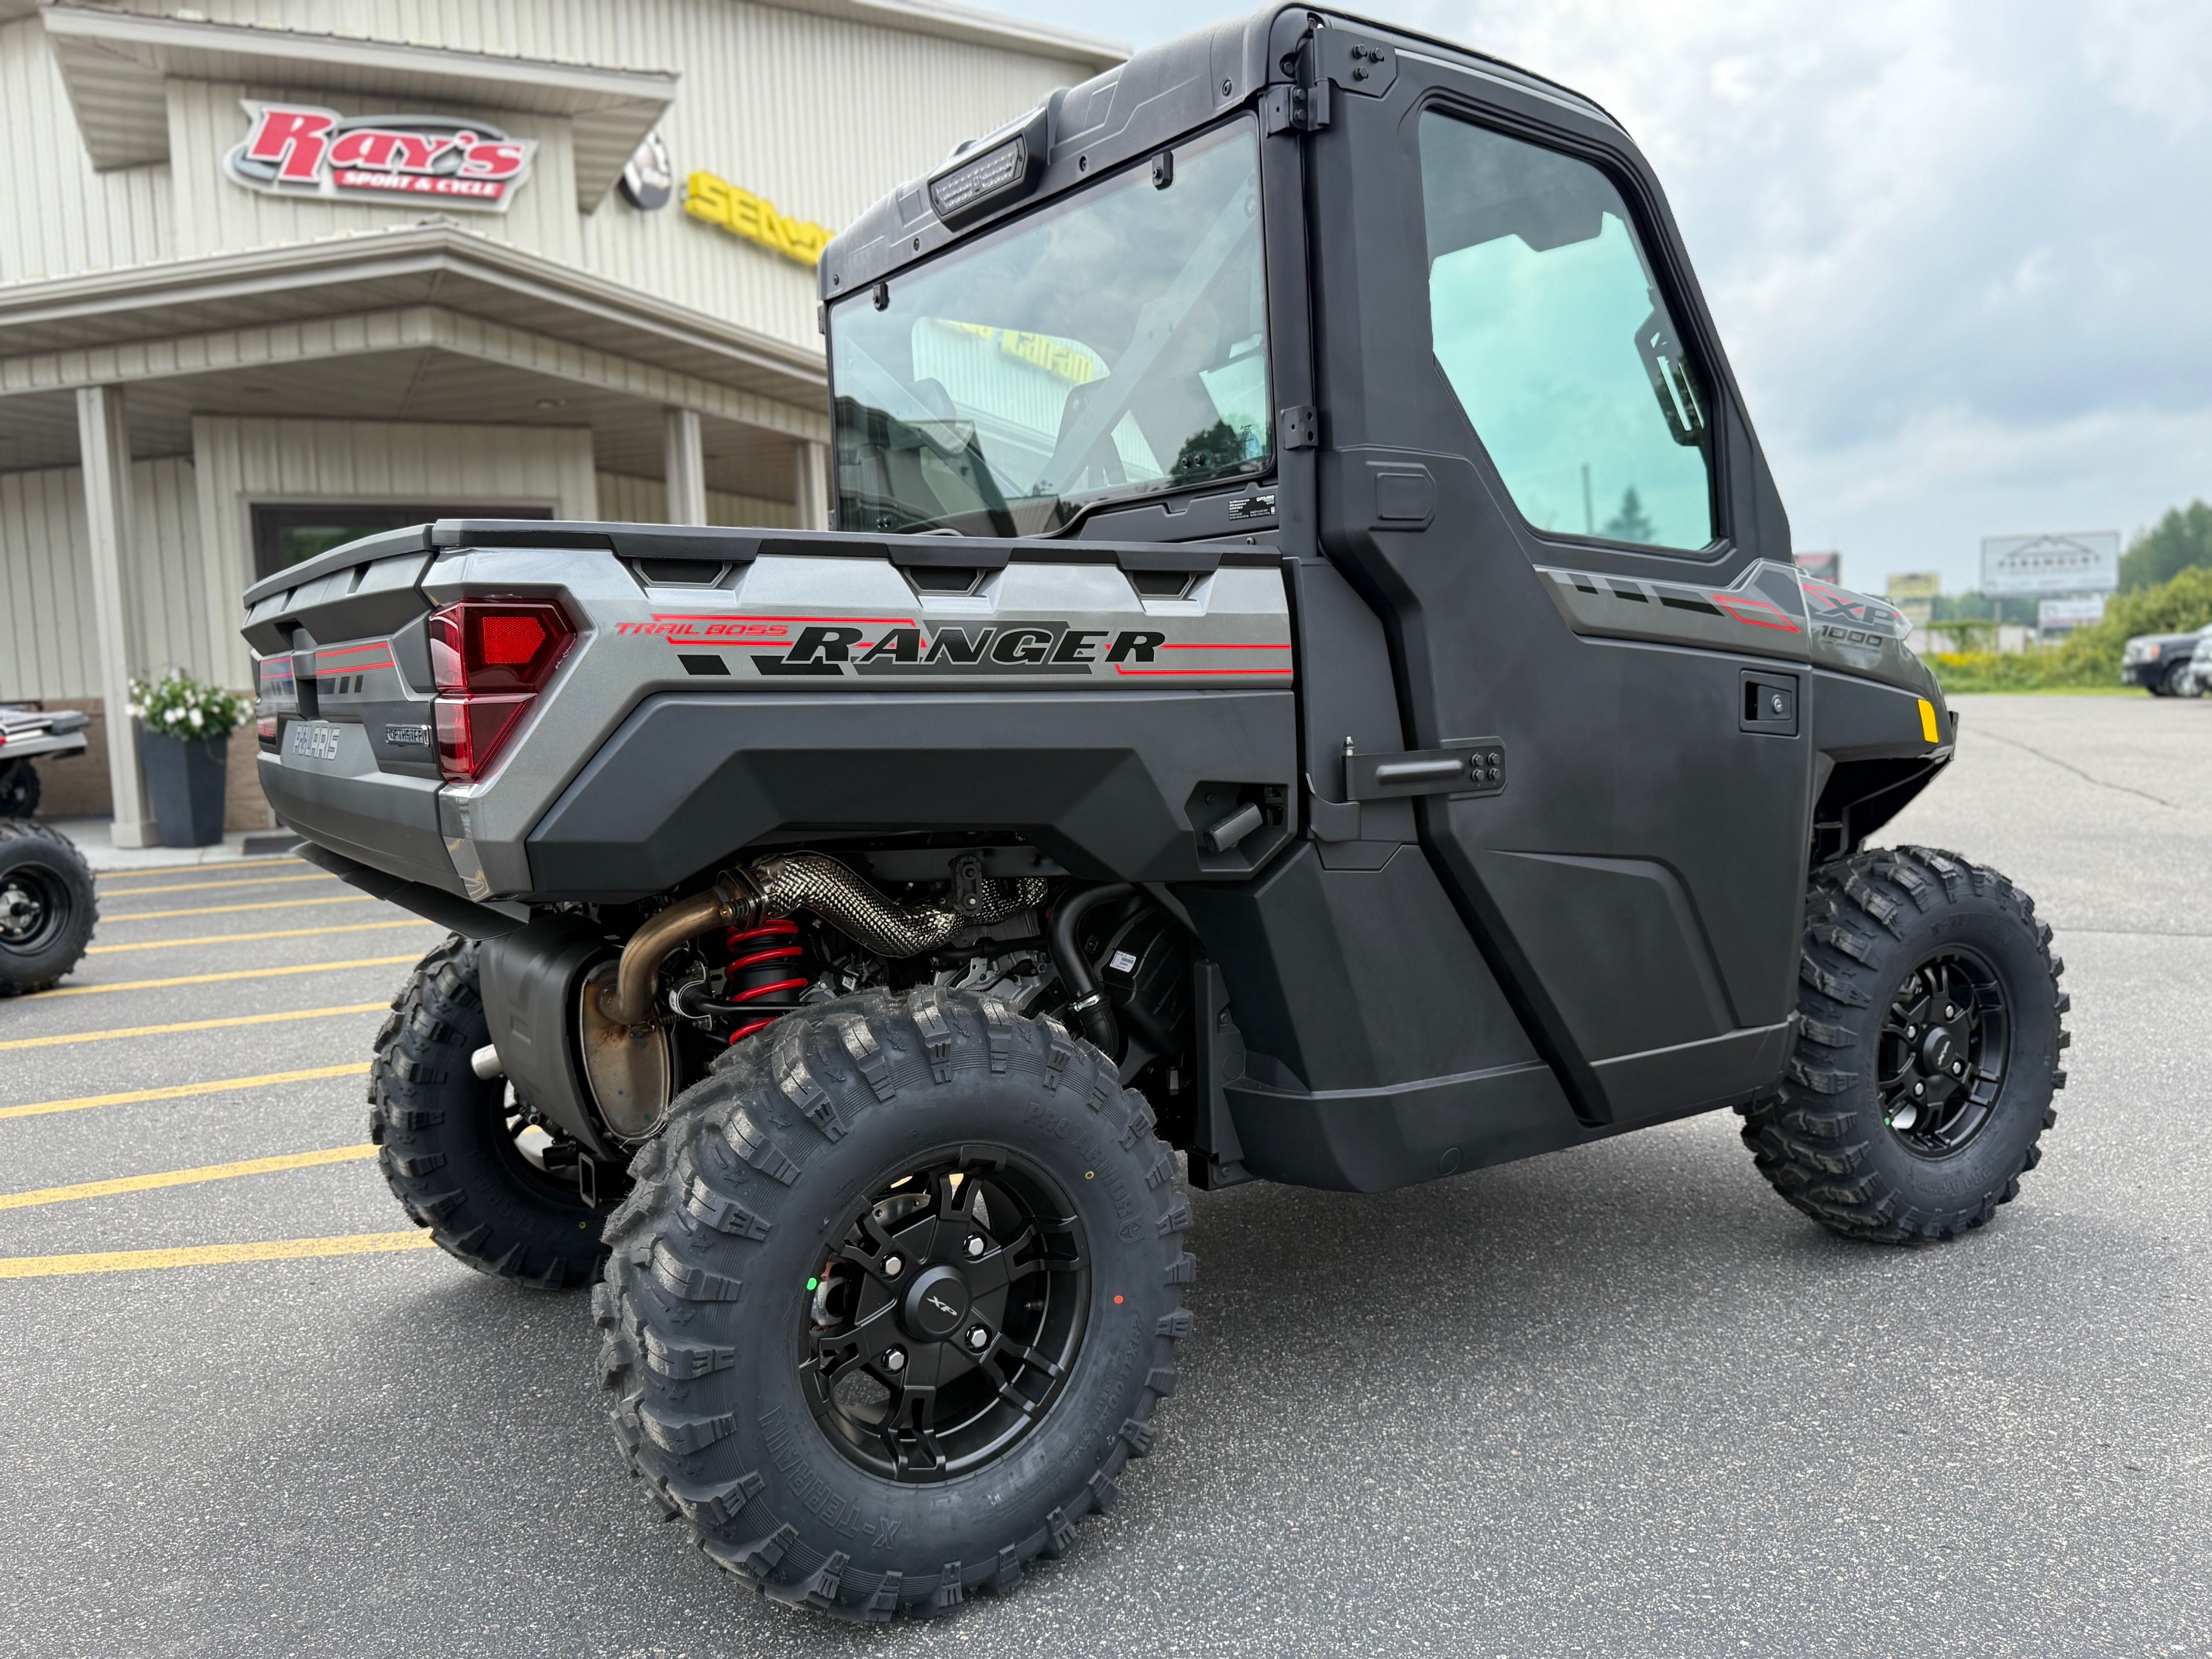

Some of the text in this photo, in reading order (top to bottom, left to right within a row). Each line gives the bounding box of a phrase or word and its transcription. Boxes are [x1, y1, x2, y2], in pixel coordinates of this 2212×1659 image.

[342, 171, 499, 196] SPORT & CYCLE
[1819, 596, 1895, 625] XP
[616, 623, 789, 637] TRAIL BOSS
[1821, 625, 1883, 647] 1000
[781, 626, 1166, 665] RANGER
[292, 725, 340, 761] POLARIS
[926, 1295, 958, 1317] XP
[758, 1405, 902, 1550] X-TERRAIN
